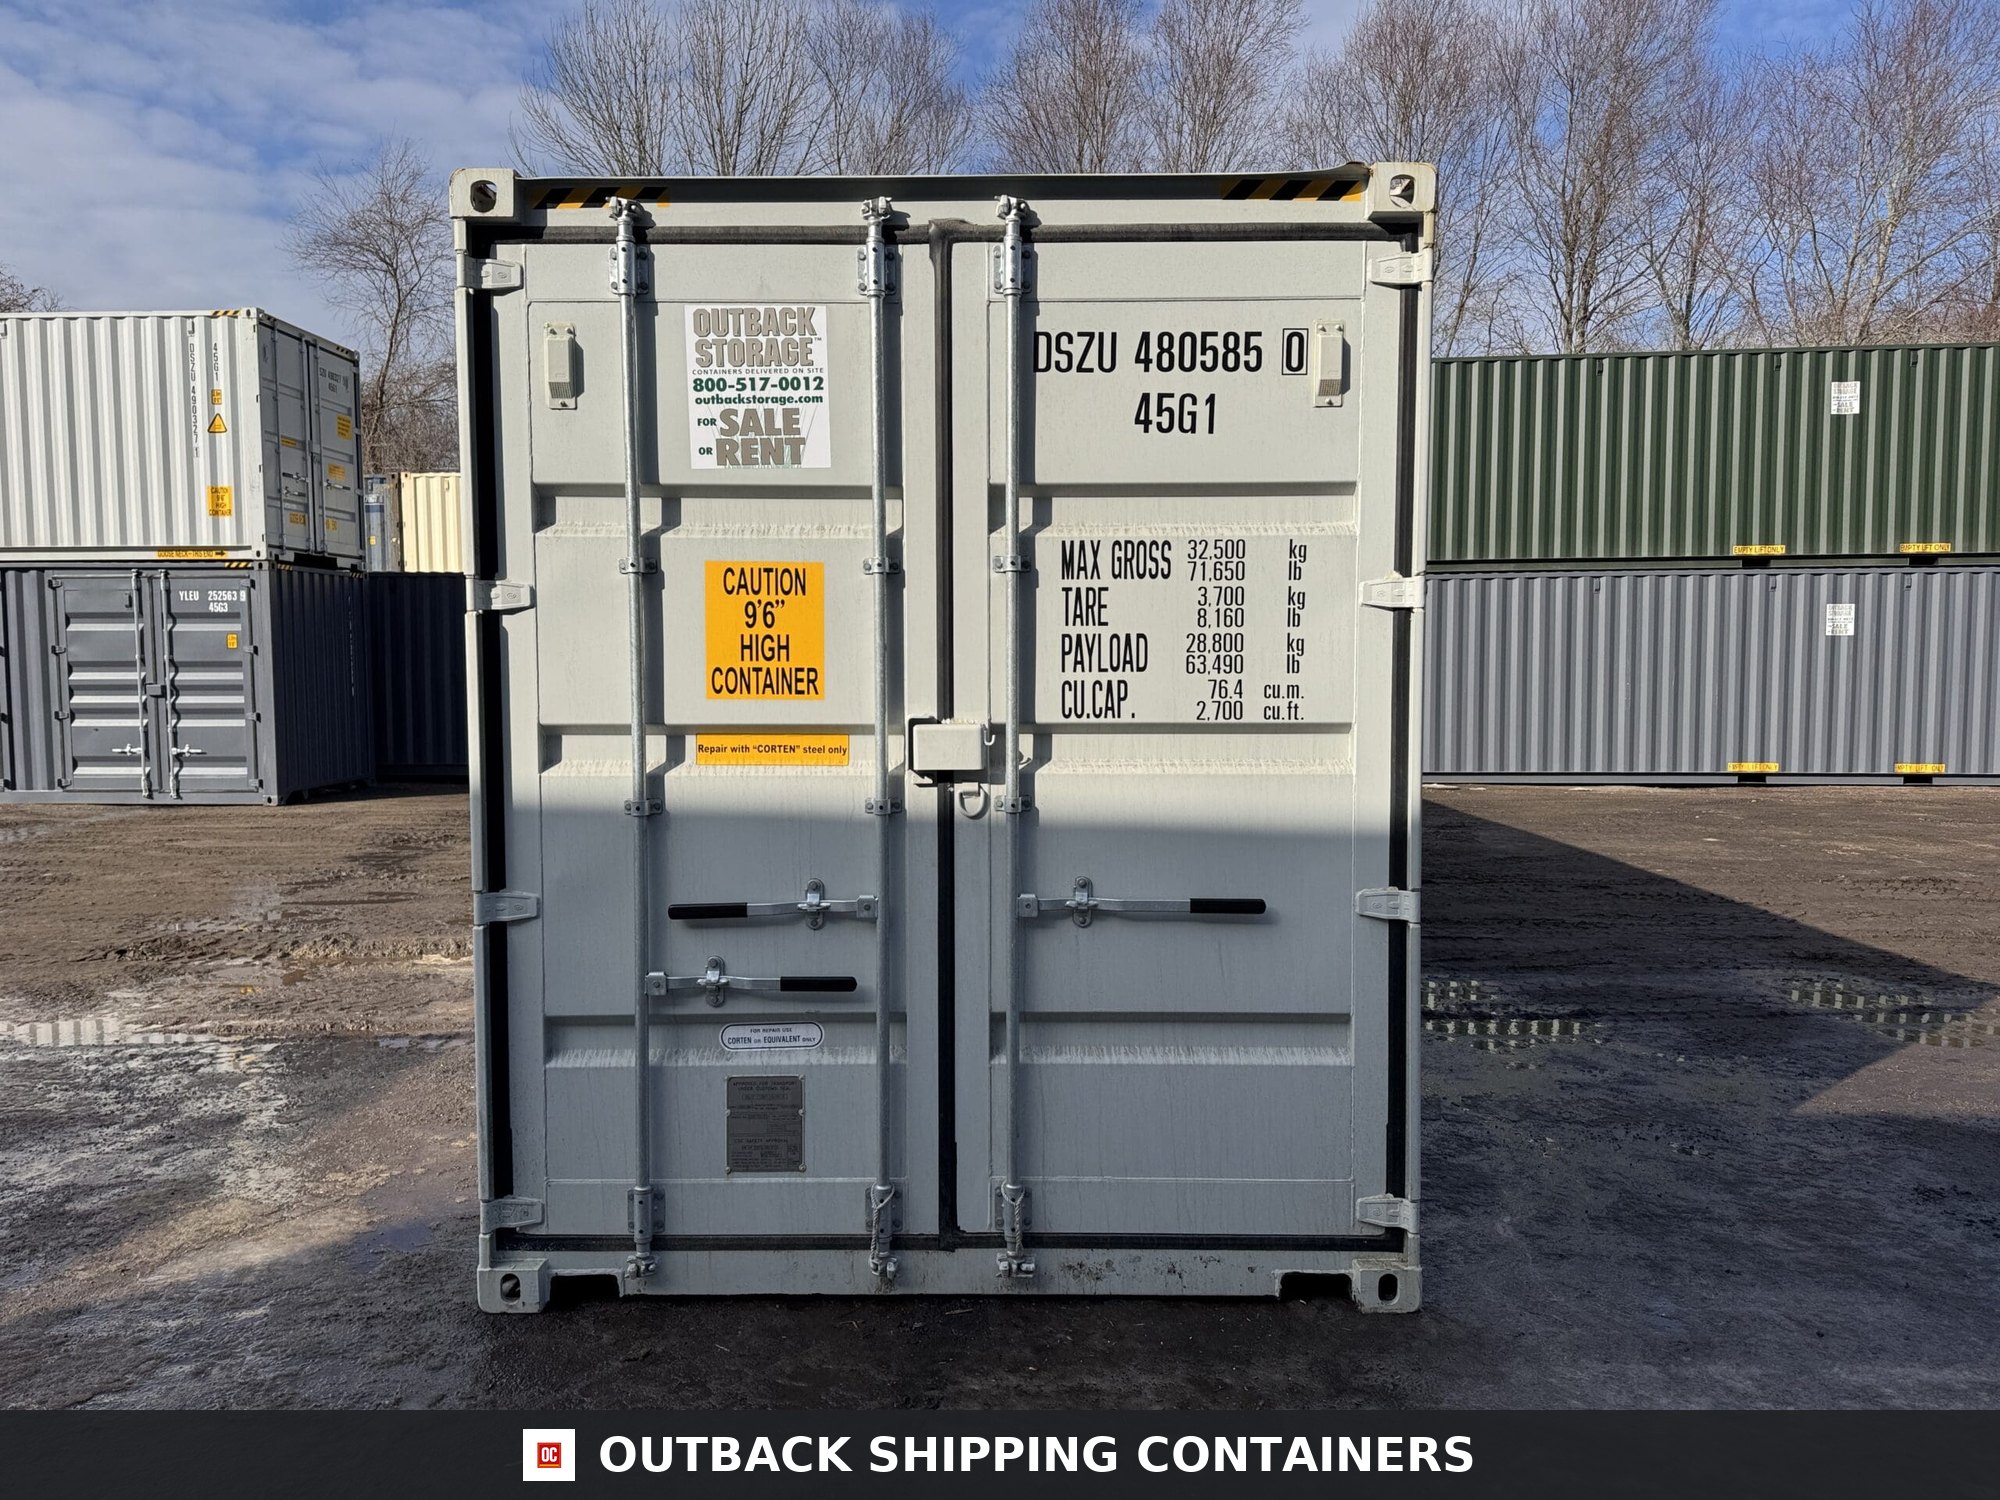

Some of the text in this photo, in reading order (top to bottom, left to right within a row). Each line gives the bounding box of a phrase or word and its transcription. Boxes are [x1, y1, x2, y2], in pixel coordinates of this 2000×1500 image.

[693, 307, 817, 337] OUTBACK
[695, 337, 814, 367] STORAGE
[1033, 330, 1305, 373] DSZU 480585 0
[692, 376, 824, 392] 800-517-0012
[695, 393, 823, 406] outbackstorage.com
[1134, 392, 1216, 434] 45G1
[697, 407, 801, 437] FOR SALE
[698, 437, 806, 466] OR RENT
[1061, 539, 1307, 580] MAX GROSS 32,500 kg
[1187, 561, 1302, 582] 71,650 lb
[179, 590, 199, 601] YLEU
[208, 590, 237, 601] 252563
[723, 567, 806, 596] CAUTION
[1061, 586, 1306, 627] TARE 3,700 kg
[1197, 608, 1301, 629] 8,160 lb
[740, 634, 790, 662] HIGH
[1061, 633, 1305, 673] PAYLOAD 28,800 kg
[1185, 654, 1300, 676] 63,490 lb
[711, 667, 819, 695] CONTAINER
[1208, 679, 1243, 700] 76.4
[1263, 683, 1304, 700] cu.m.
[1196, 701, 1304, 722] 2,700 cu.ft.
[698, 744, 728, 755] Repair
[730, 744, 750, 753] with
[803, 745, 826, 754] steel
[828, 746, 847, 756] only
[728, 1036, 752, 1044] CORTEN
[763, 1035, 800, 1043] EQUIVALENT
